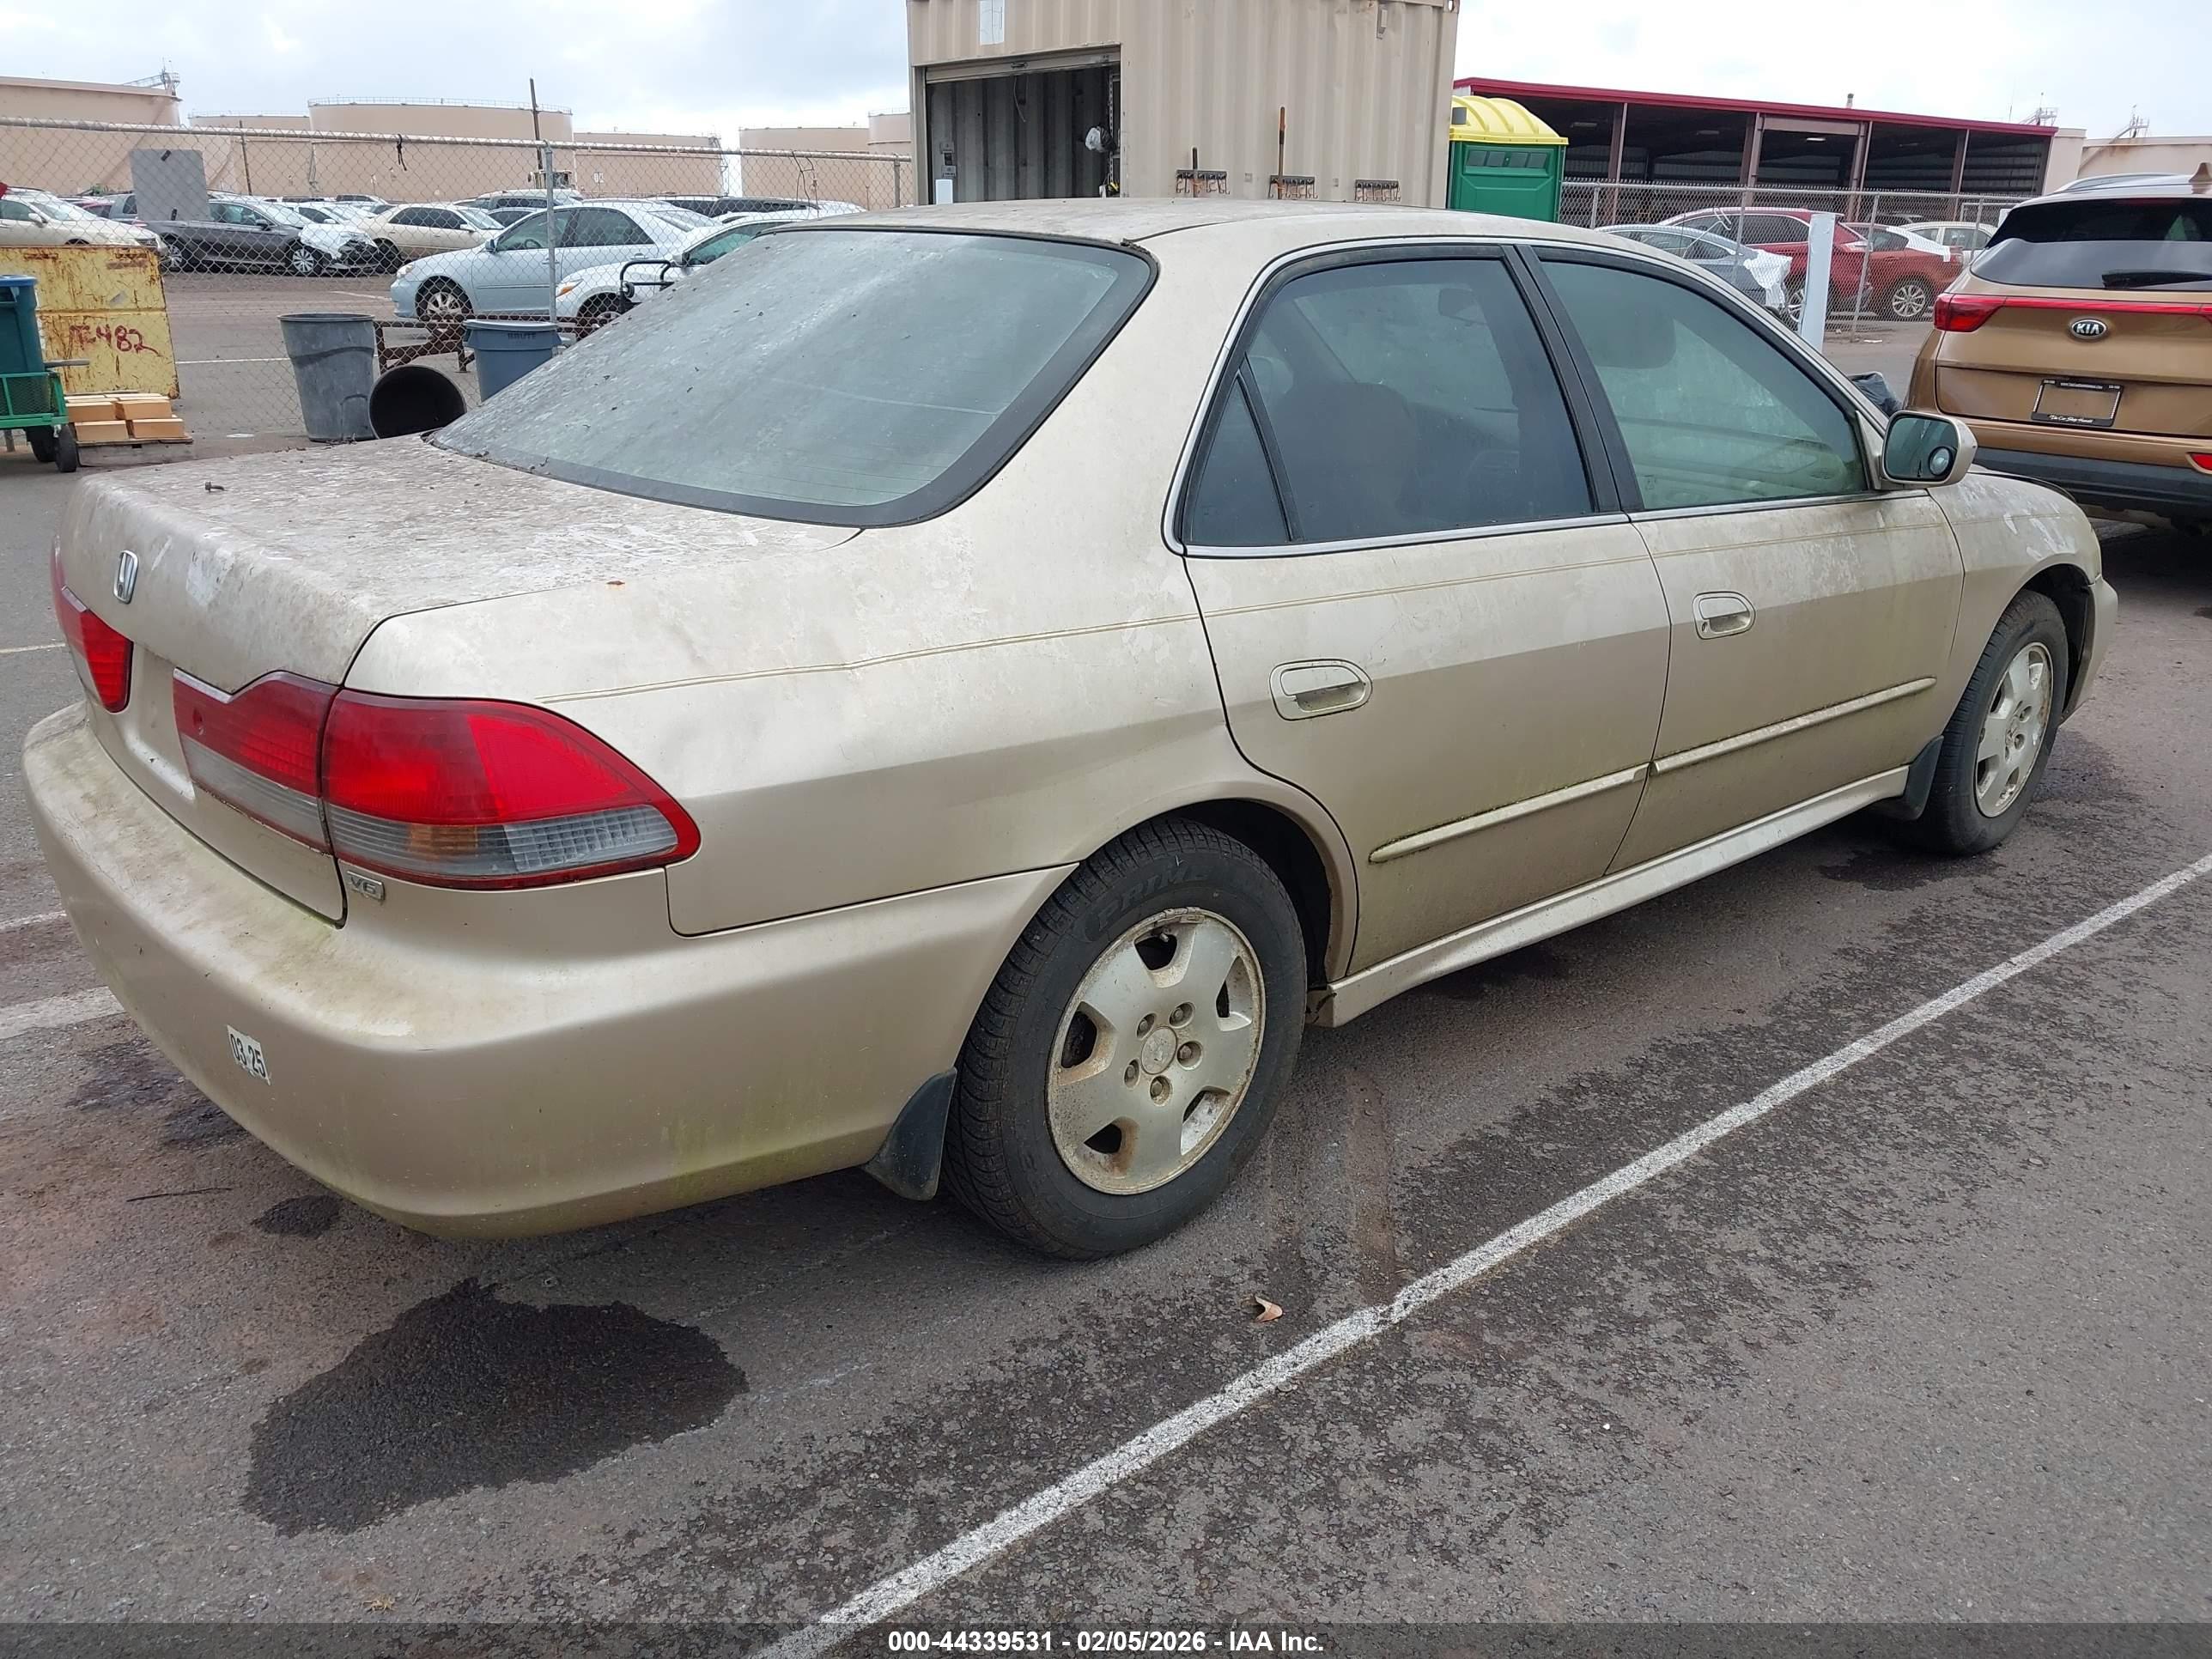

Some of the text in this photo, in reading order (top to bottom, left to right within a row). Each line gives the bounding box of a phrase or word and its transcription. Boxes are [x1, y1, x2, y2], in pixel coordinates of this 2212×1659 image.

[2076, 322, 2100, 335] KIA
[350, 876, 376, 895] V6
[230, 1033, 266, 1079] 03 25
